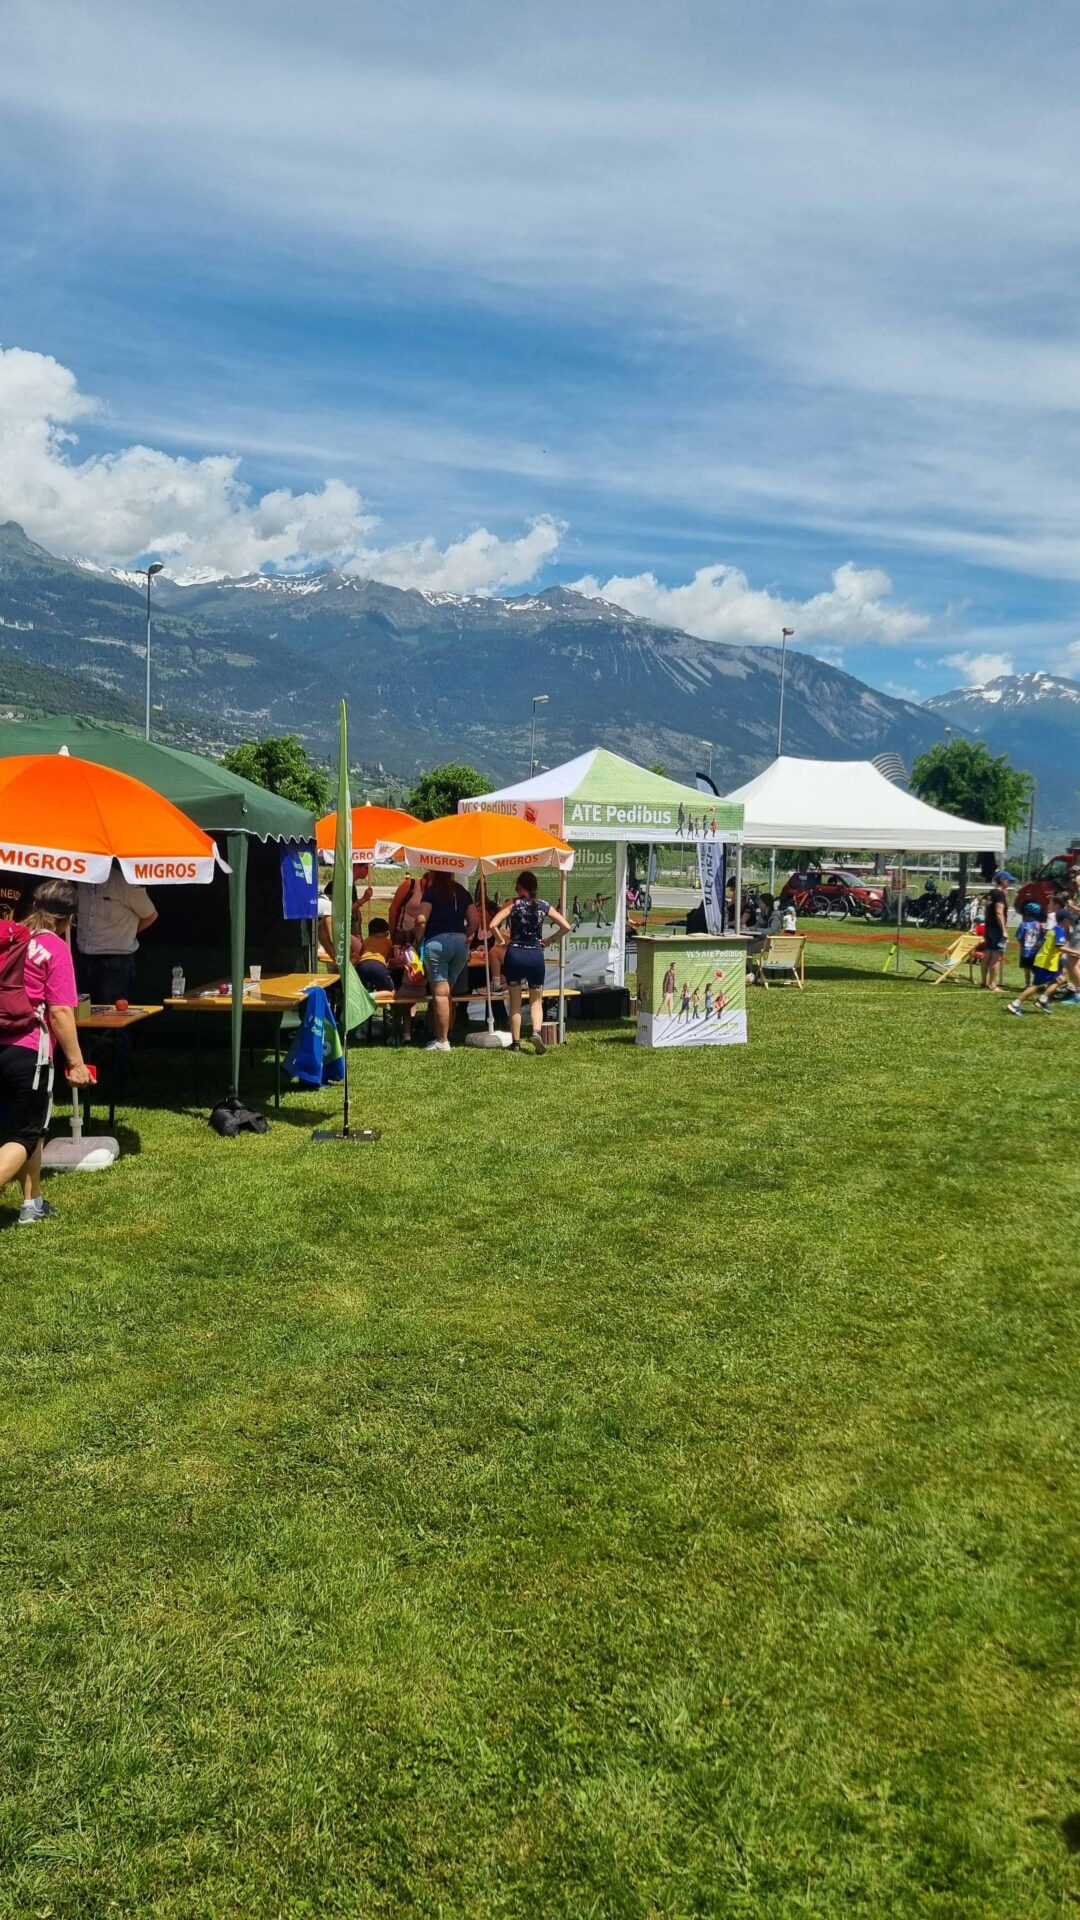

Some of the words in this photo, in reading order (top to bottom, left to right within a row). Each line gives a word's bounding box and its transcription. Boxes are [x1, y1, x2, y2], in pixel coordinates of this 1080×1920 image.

[571, 803, 602, 822] ATE
[606, 804, 672, 824] Pedibus
[0, 849, 87, 874] MIGROS
[352, 852, 374, 861] GRO
[419, 854, 465, 868] MIGROS
[496, 854, 539, 868] MIGROS
[574, 849, 613, 864] dibus
[134, 863, 197, 879] MIGROS
[27, 939, 52, 966] NT
[715, 949, 743, 958] Pedibus
